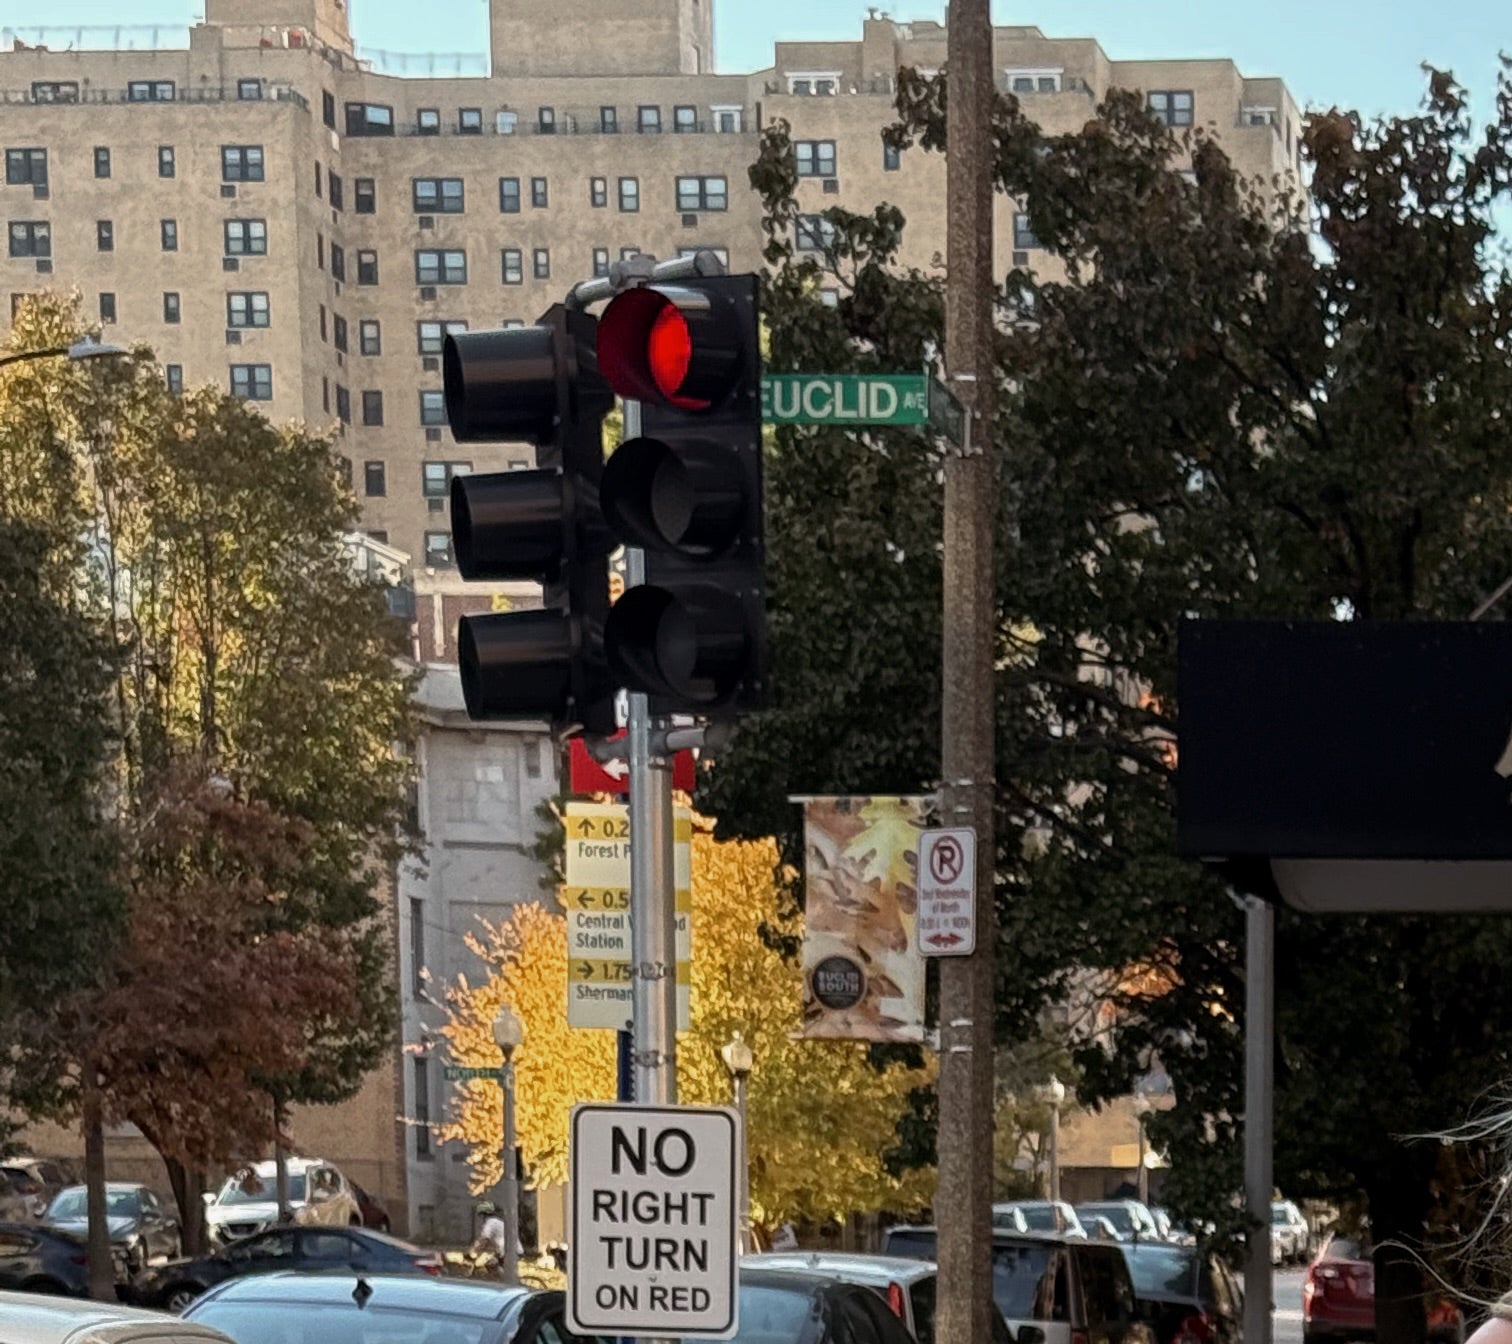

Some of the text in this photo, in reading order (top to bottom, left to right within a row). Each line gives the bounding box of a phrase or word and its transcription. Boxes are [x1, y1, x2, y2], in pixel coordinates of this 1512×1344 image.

[903, 391, 926, 410] AVE
[578, 842, 620, 858] Forest
[576, 913, 624, 930] Central
[576, 933, 624, 949] Station
[611, 1125, 697, 1178] NO
[592, 1189, 715, 1226] RIGHT
[599, 1235, 709, 1272] TURN
[595, 1284, 711, 1312] ON RED
